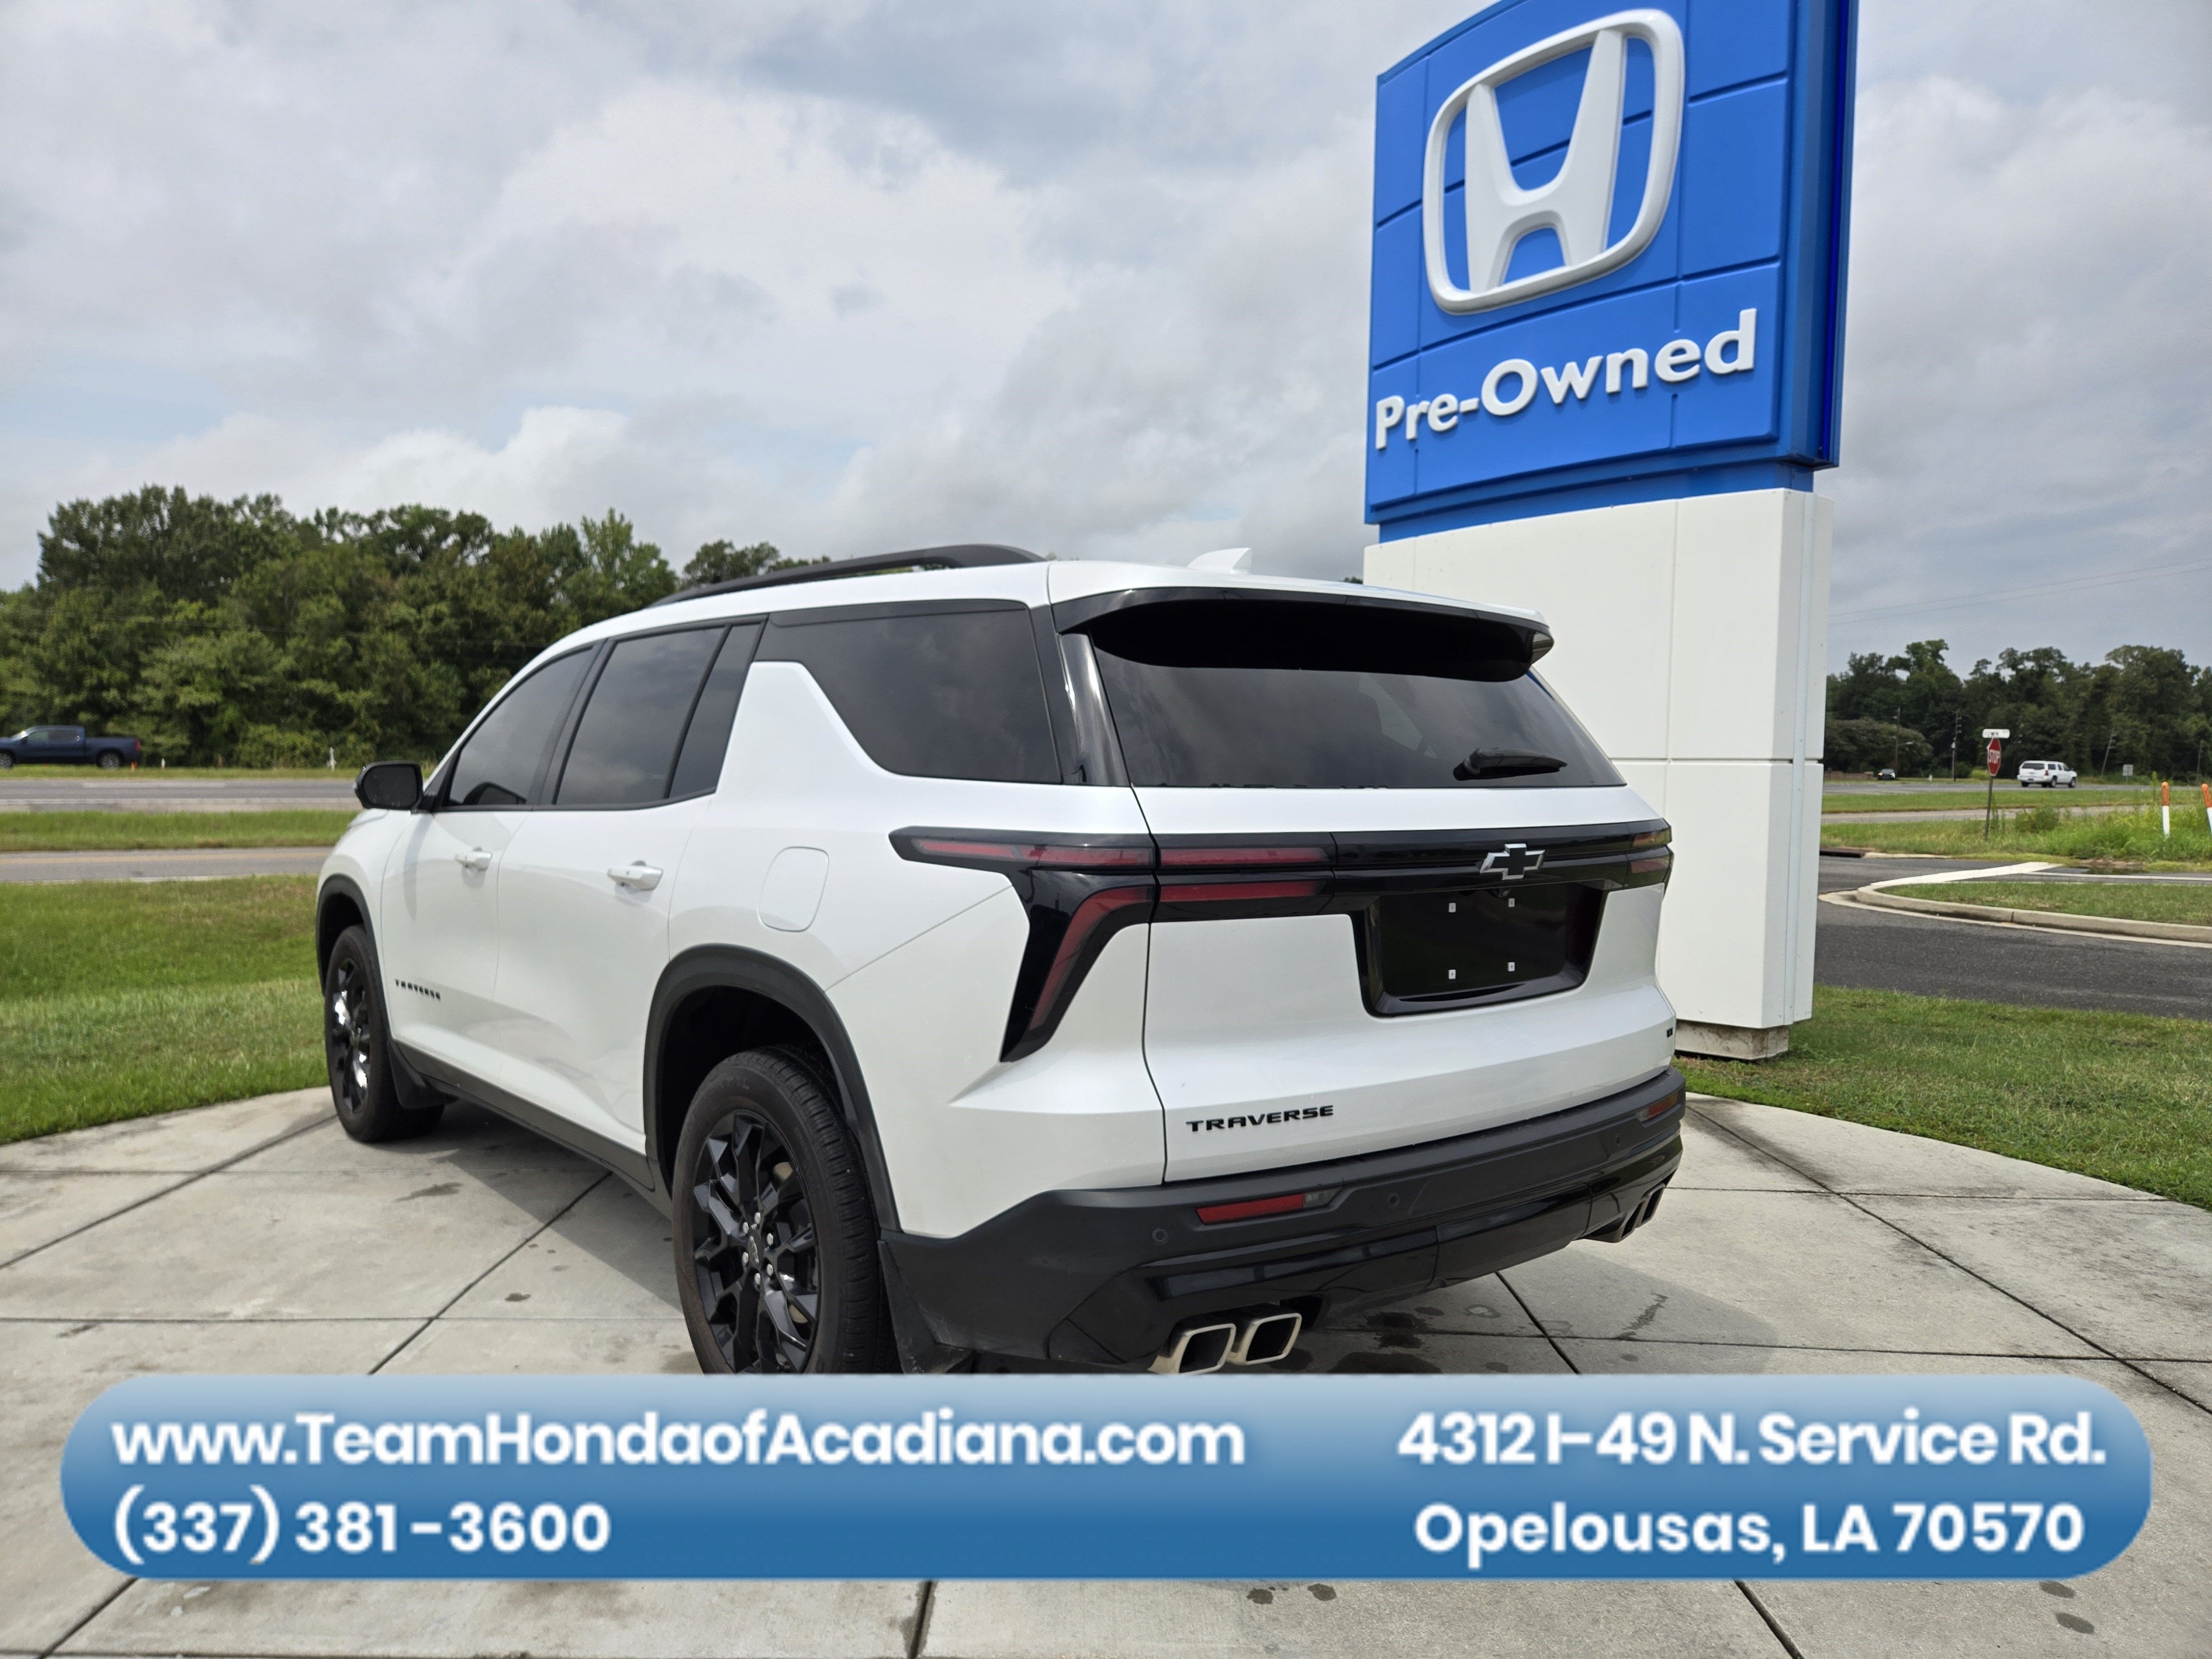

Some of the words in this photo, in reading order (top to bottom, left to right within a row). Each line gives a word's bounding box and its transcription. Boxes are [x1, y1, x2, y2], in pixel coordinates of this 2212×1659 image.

[1375, 307, 1757, 450] Pre-Owned
[1989, 749, 2001, 764] STOP
[1186, 1105, 1334, 1132] TRAVERSE
